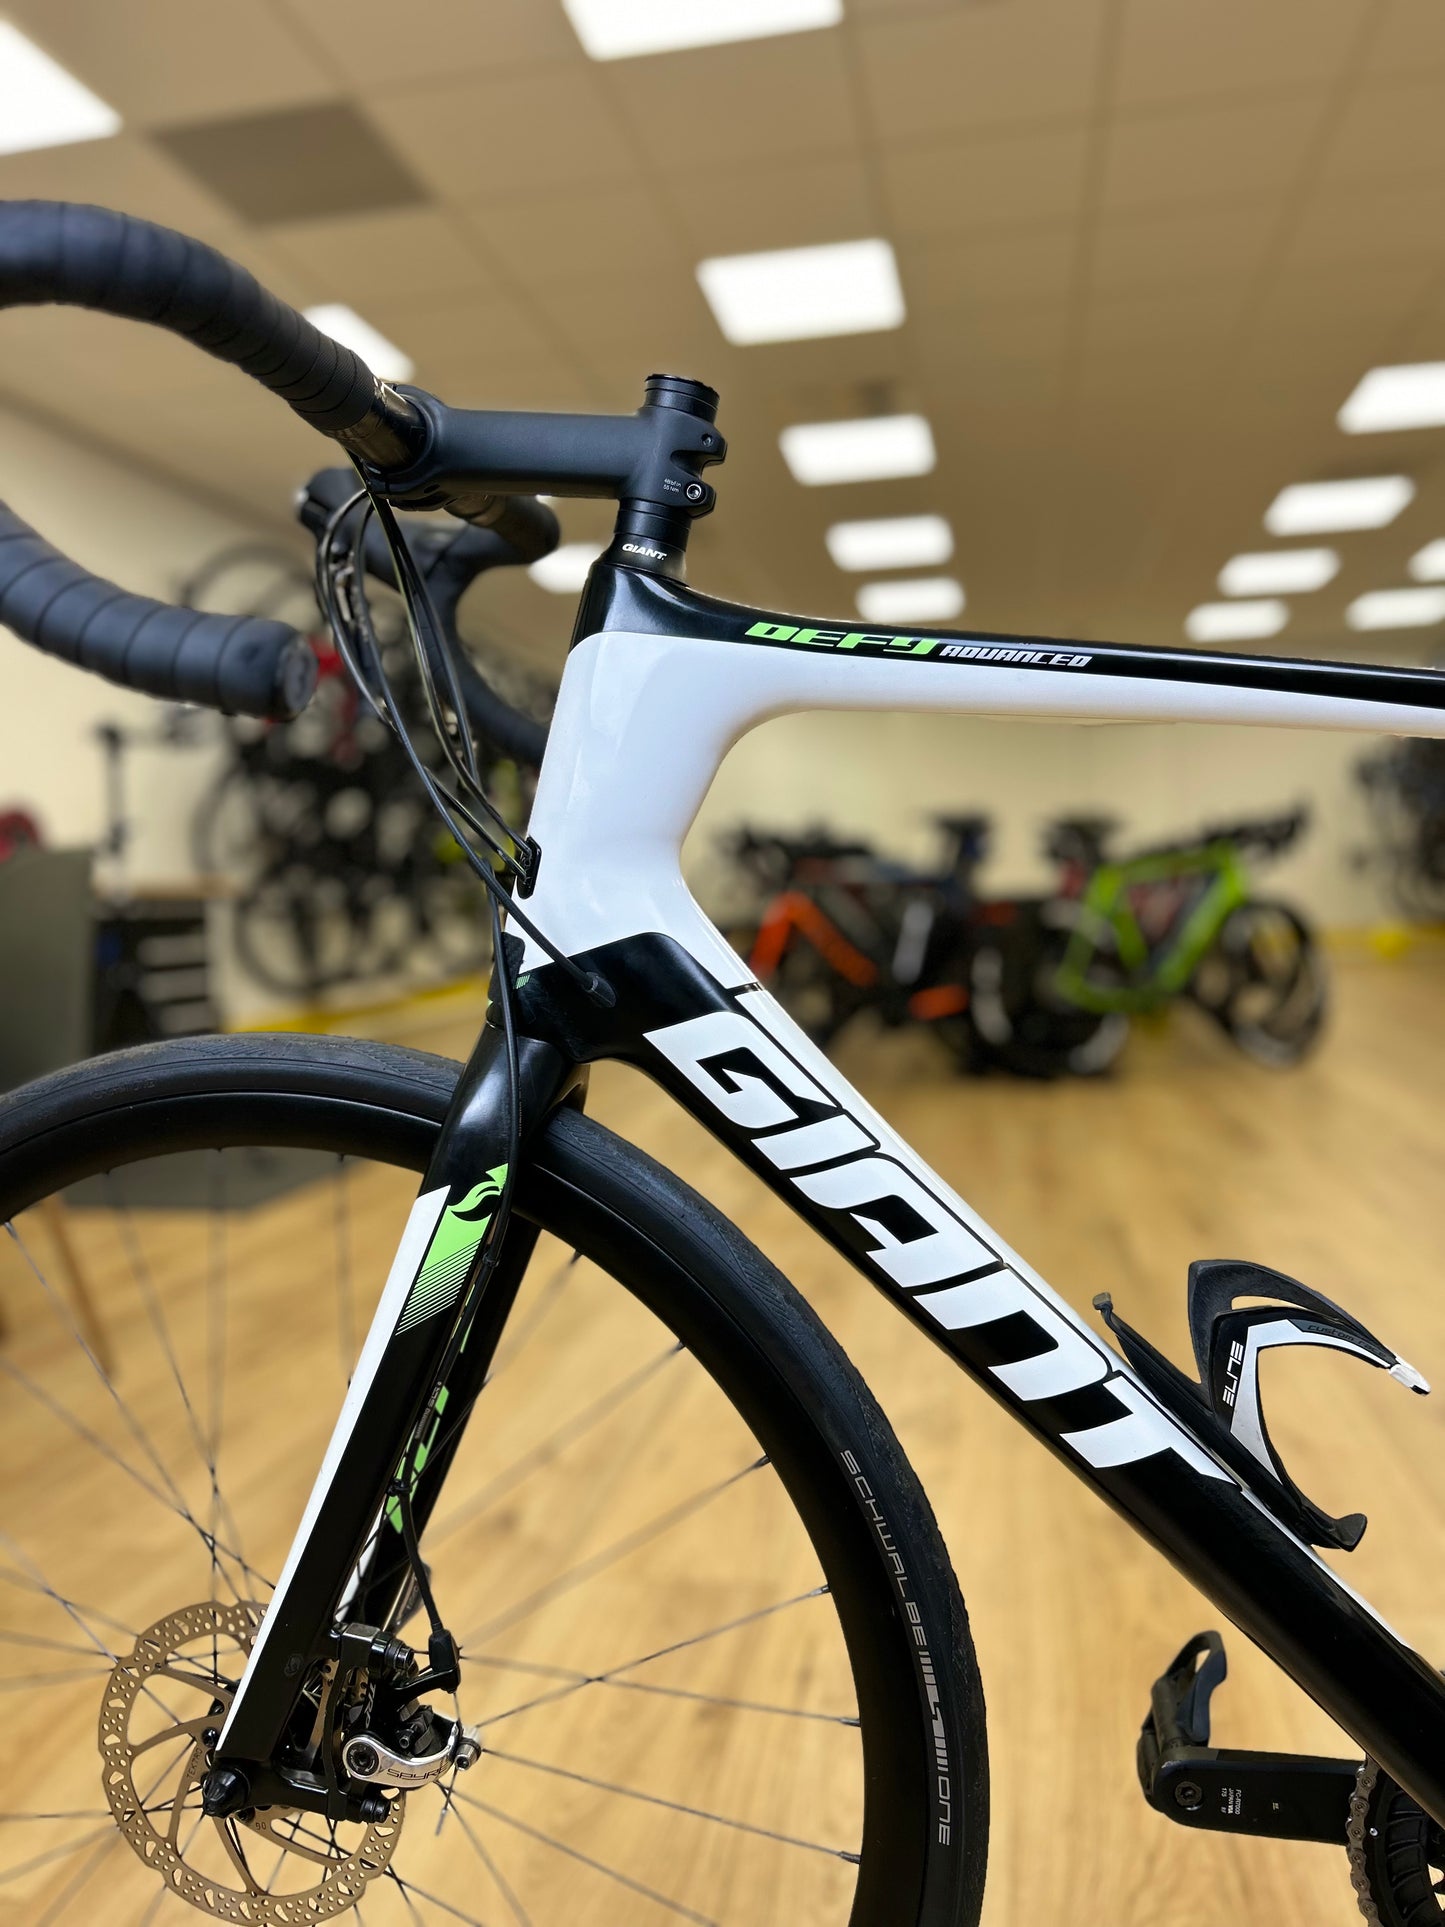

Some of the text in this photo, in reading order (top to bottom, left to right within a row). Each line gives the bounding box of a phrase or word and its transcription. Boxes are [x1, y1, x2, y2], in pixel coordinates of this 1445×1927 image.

[745, 622, 1093, 668] DEFY ADVANCED
[642, 1011, 1237, 1486] GIANT
[1222, 1340, 1244, 1407] ELITE
[840, 1449, 951, 1846] SCHWALBE ONE
